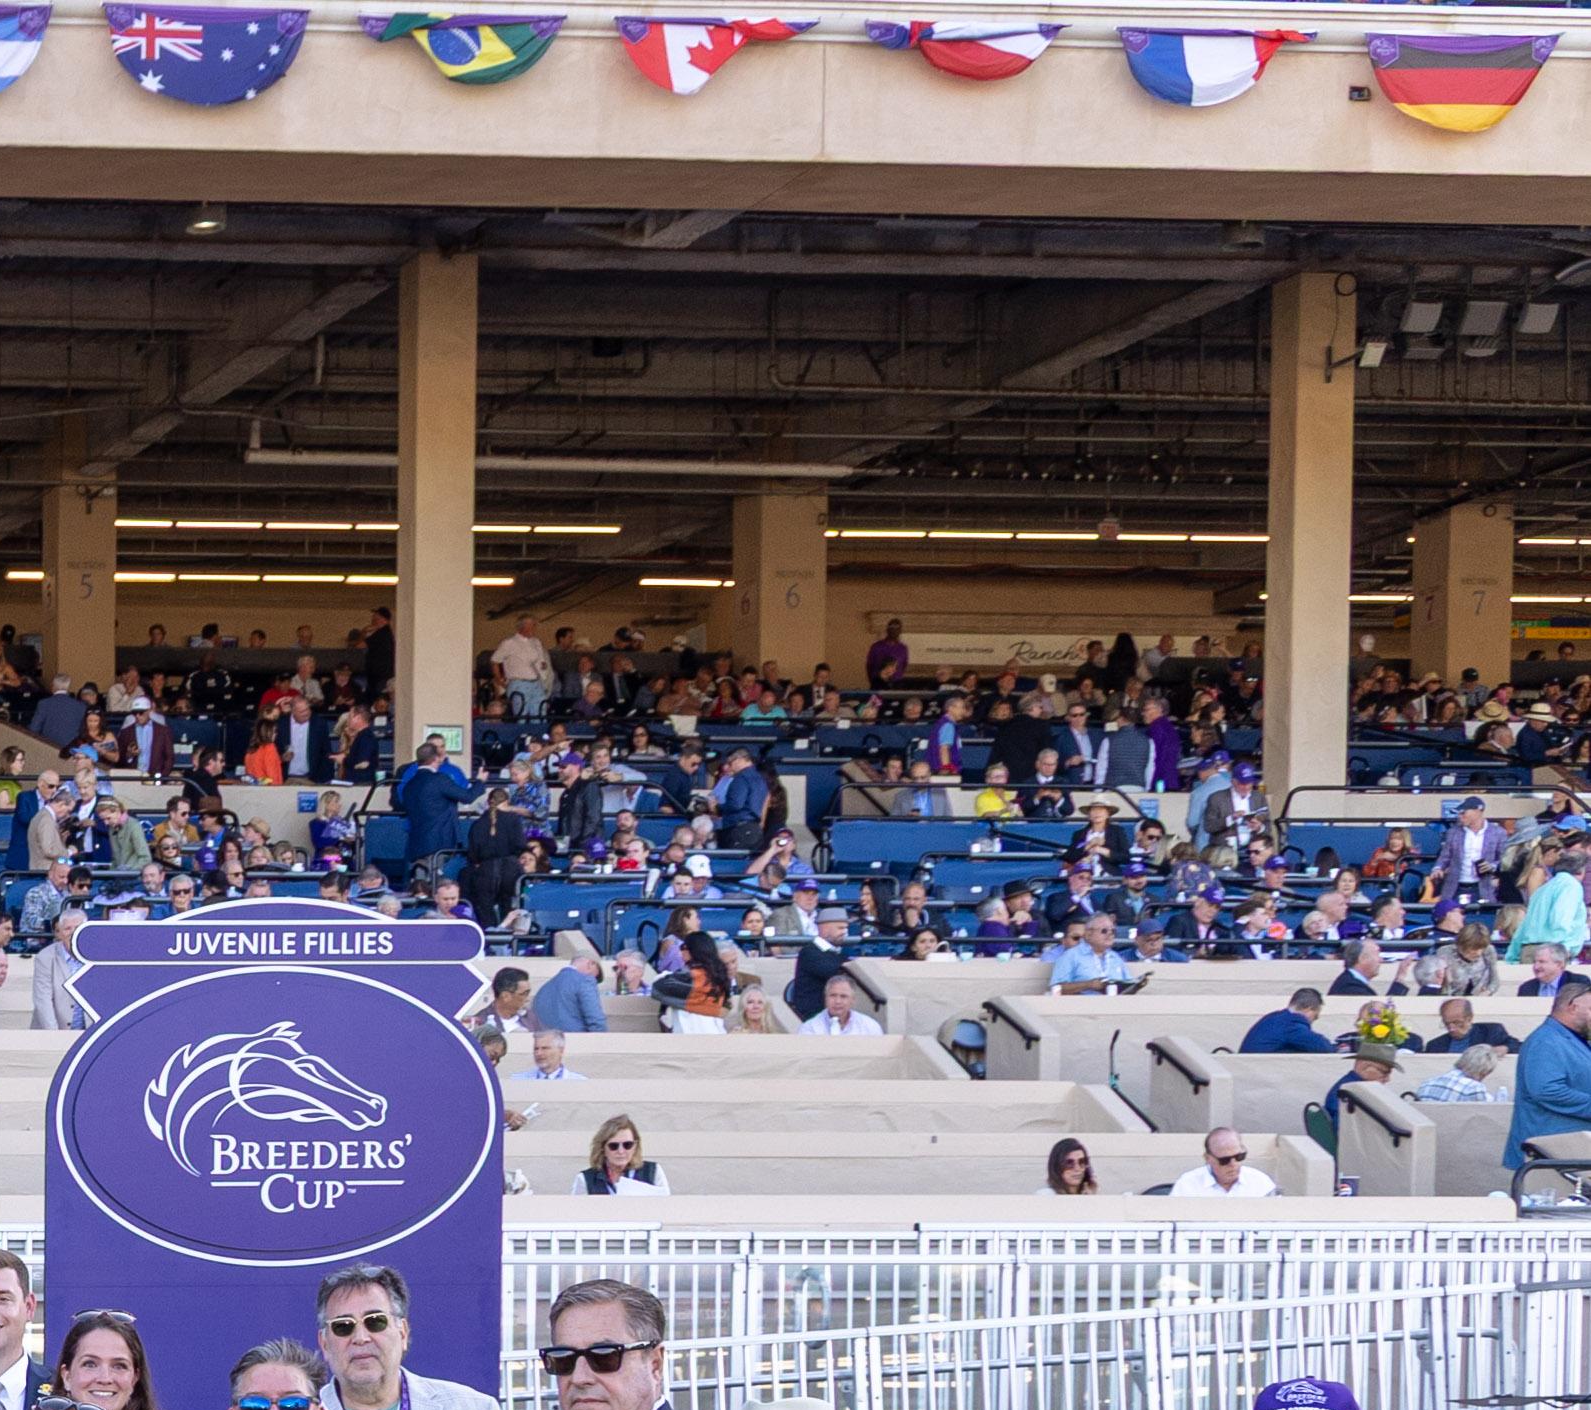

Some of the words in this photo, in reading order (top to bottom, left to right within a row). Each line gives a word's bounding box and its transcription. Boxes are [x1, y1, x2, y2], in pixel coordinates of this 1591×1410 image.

[80, 573, 95, 600] 5
[784, 584, 801, 610] 6
[1471, 591, 1487, 617] 7
[167, 931, 297, 956] JUVENILE
[304, 931, 394, 955] FILLIES
[210, 1134, 413, 1175] BREEDERS'
[260, 1173, 345, 1213] CUP
